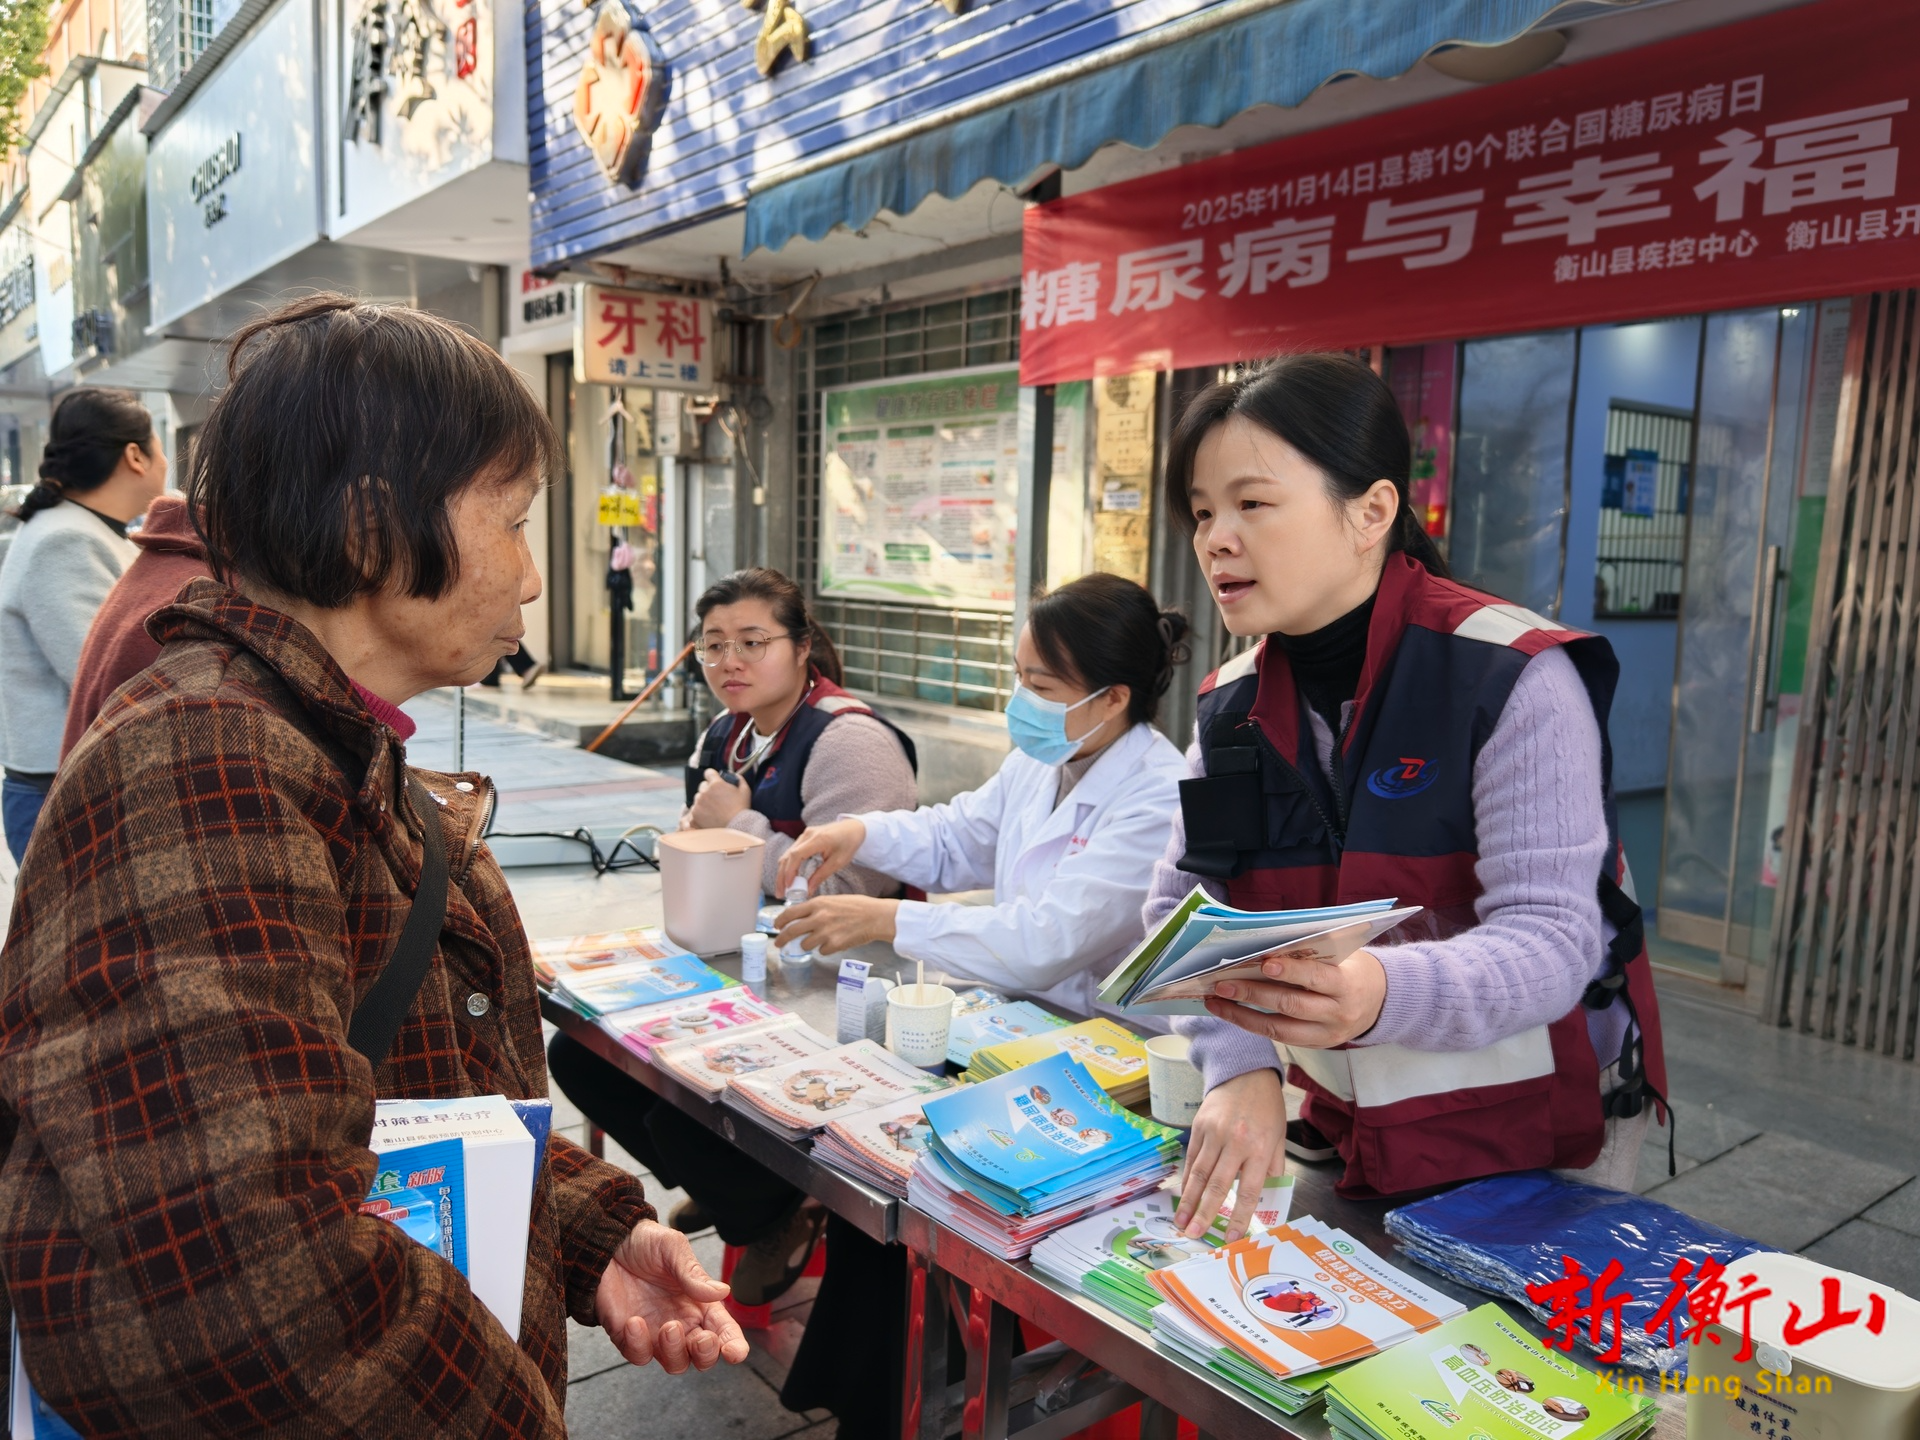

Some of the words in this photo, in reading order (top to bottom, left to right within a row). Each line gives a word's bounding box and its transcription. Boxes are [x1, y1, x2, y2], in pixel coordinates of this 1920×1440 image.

[1181, 74, 1764, 230] 2025年11月14日是第19个联合国糖尿病日
[1020, 98, 1909, 331] 糖尿病与幸福
[1553, 228, 1759, 283] 衡山县疾控中心
[597, 293, 706, 362] 牙科
[608, 358, 699, 383] 请上二楼
[1012, 1093, 1090, 1152] 糖尿病防治知识
[406, 1166, 446, 1189] 新版
[1314, 1248, 1413, 1311] 健康教育处方
[1441, 1353, 1565, 1436] 高血压防治知识
